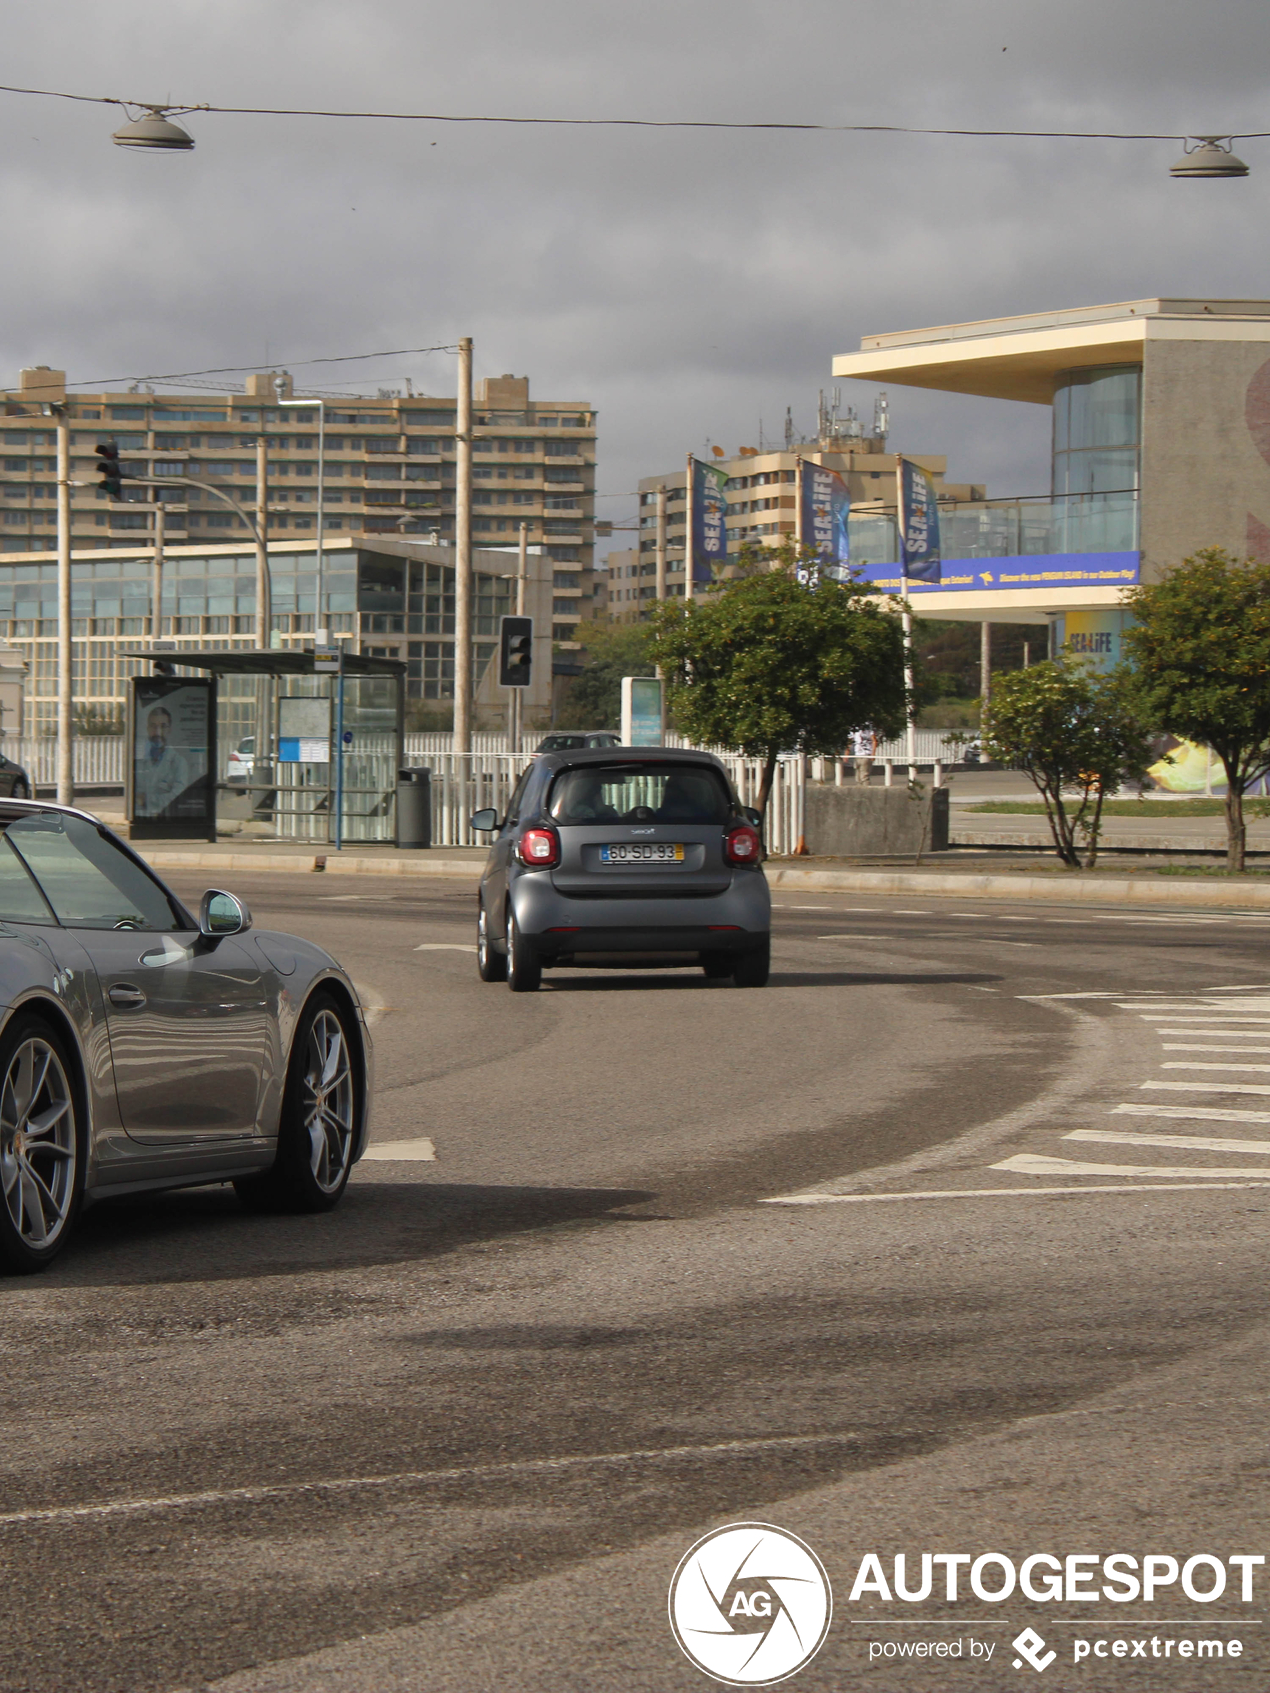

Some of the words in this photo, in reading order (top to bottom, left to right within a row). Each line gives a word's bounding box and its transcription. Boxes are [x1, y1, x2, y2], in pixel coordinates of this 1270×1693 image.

[703, 512, 722, 551] SEA
[813, 515, 833, 553] SEA
[906, 516, 928, 553] SEA
[610, 845, 675, 859] 60-SD-93
